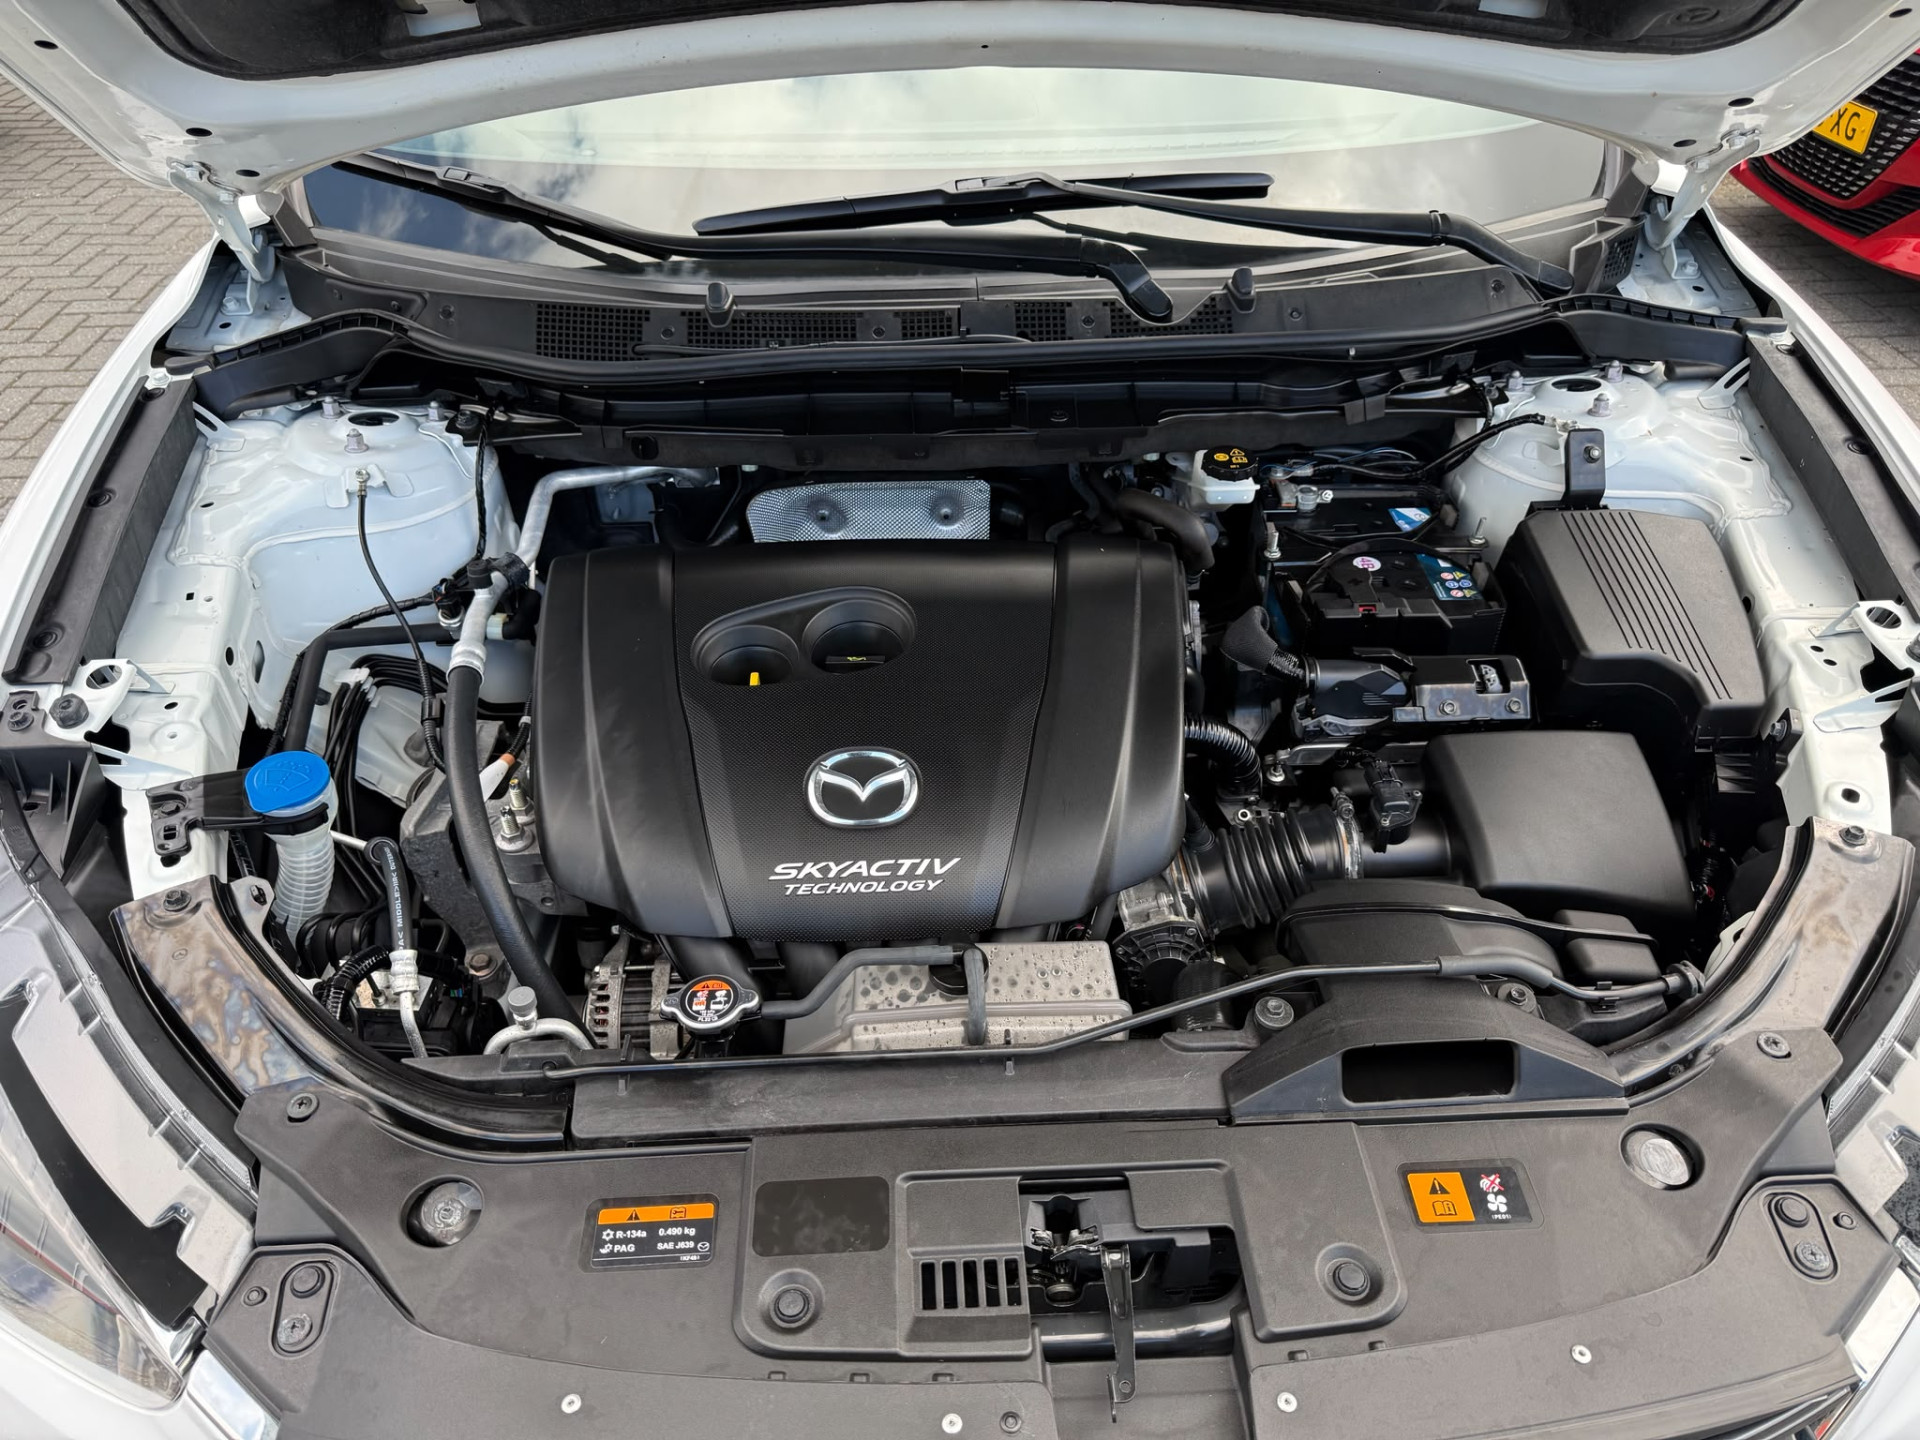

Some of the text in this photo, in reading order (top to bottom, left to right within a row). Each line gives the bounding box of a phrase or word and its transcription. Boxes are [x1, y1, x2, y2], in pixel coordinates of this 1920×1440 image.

[1823, 107, 1861, 141] XG
[768, 857, 961, 881] SKYACTIV
[784, 879, 944, 896] TECHNOLOGY
[616, 1226, 696, 1239] R-134a 0.490 kg
[614, 1241, 695, 1253] PAG SAE J639
